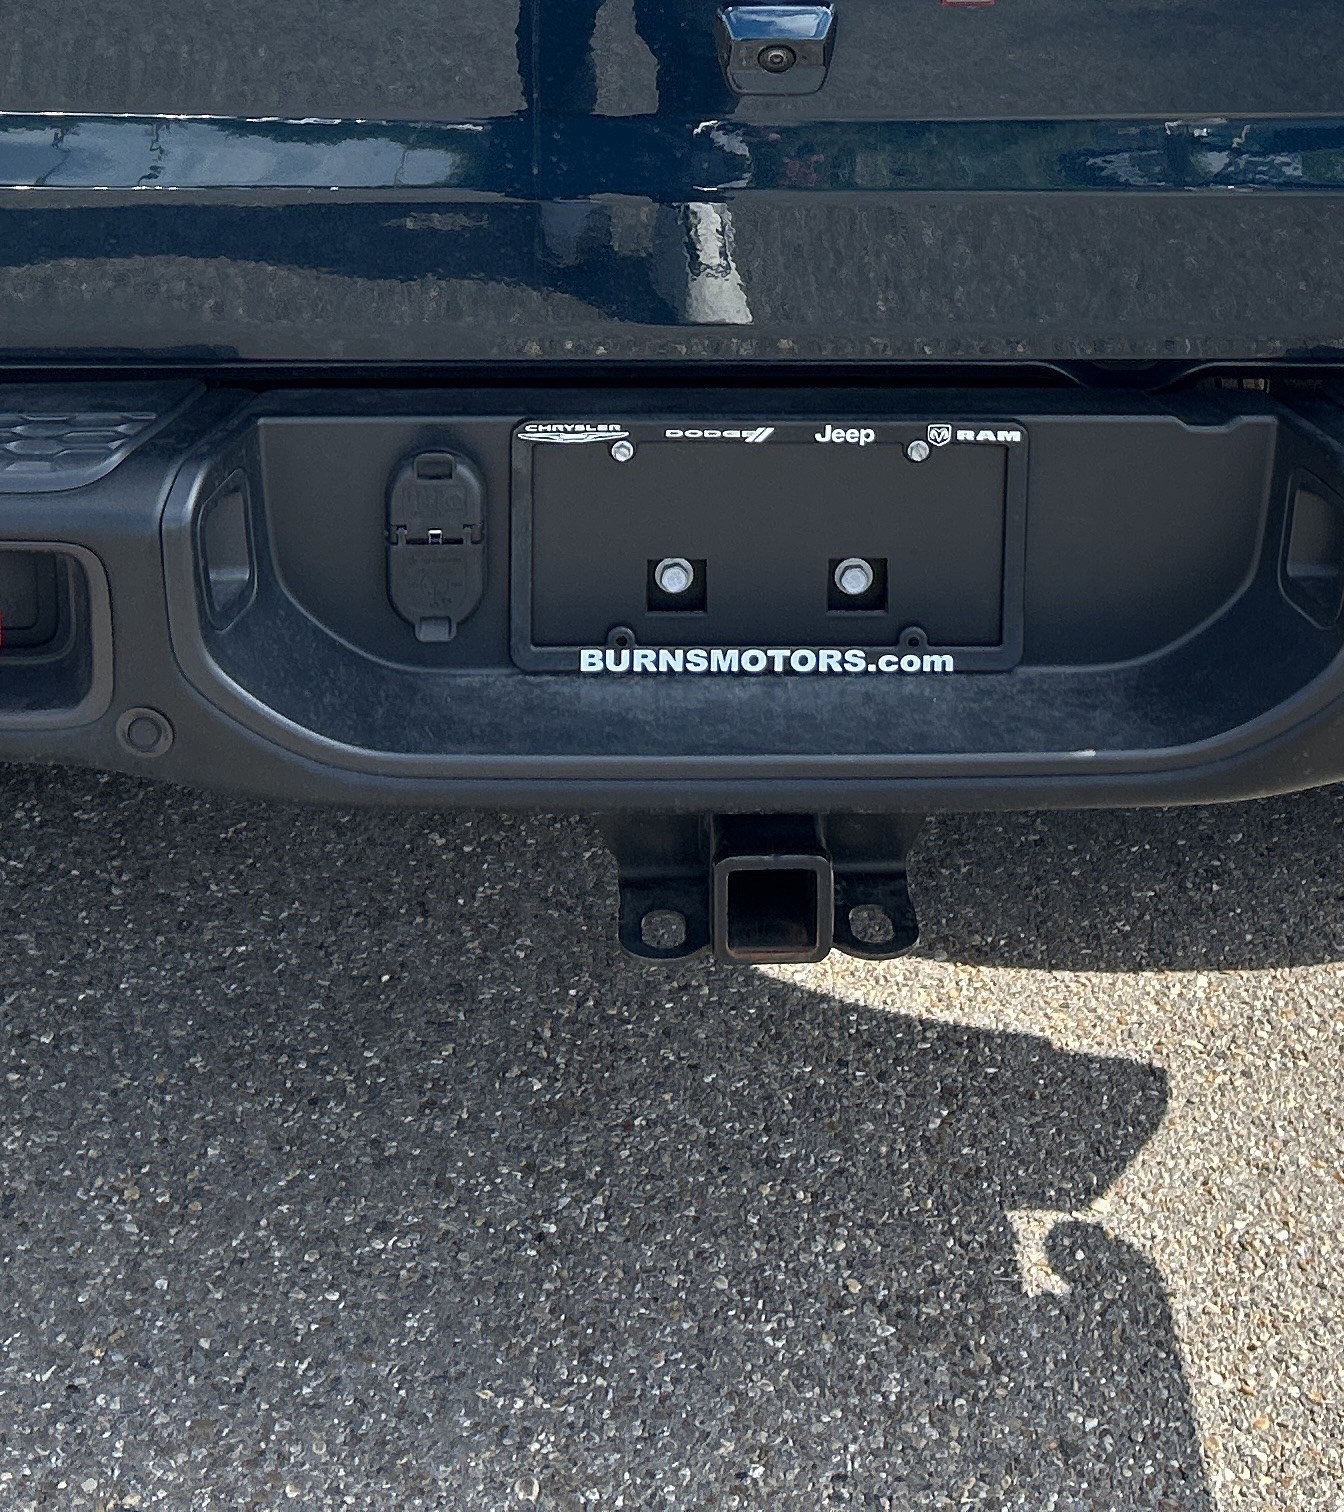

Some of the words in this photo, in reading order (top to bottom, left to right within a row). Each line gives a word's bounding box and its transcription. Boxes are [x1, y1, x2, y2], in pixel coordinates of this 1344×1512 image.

[524, 424, 621, 432] CHRYSLER
[665, 429, 757, 438] DODGE
[814, 424, 876, 446] Jeep
[956, 429, 1022, 442] RAM
[580, 648, 955, 673] BURNSMOTORS.com
